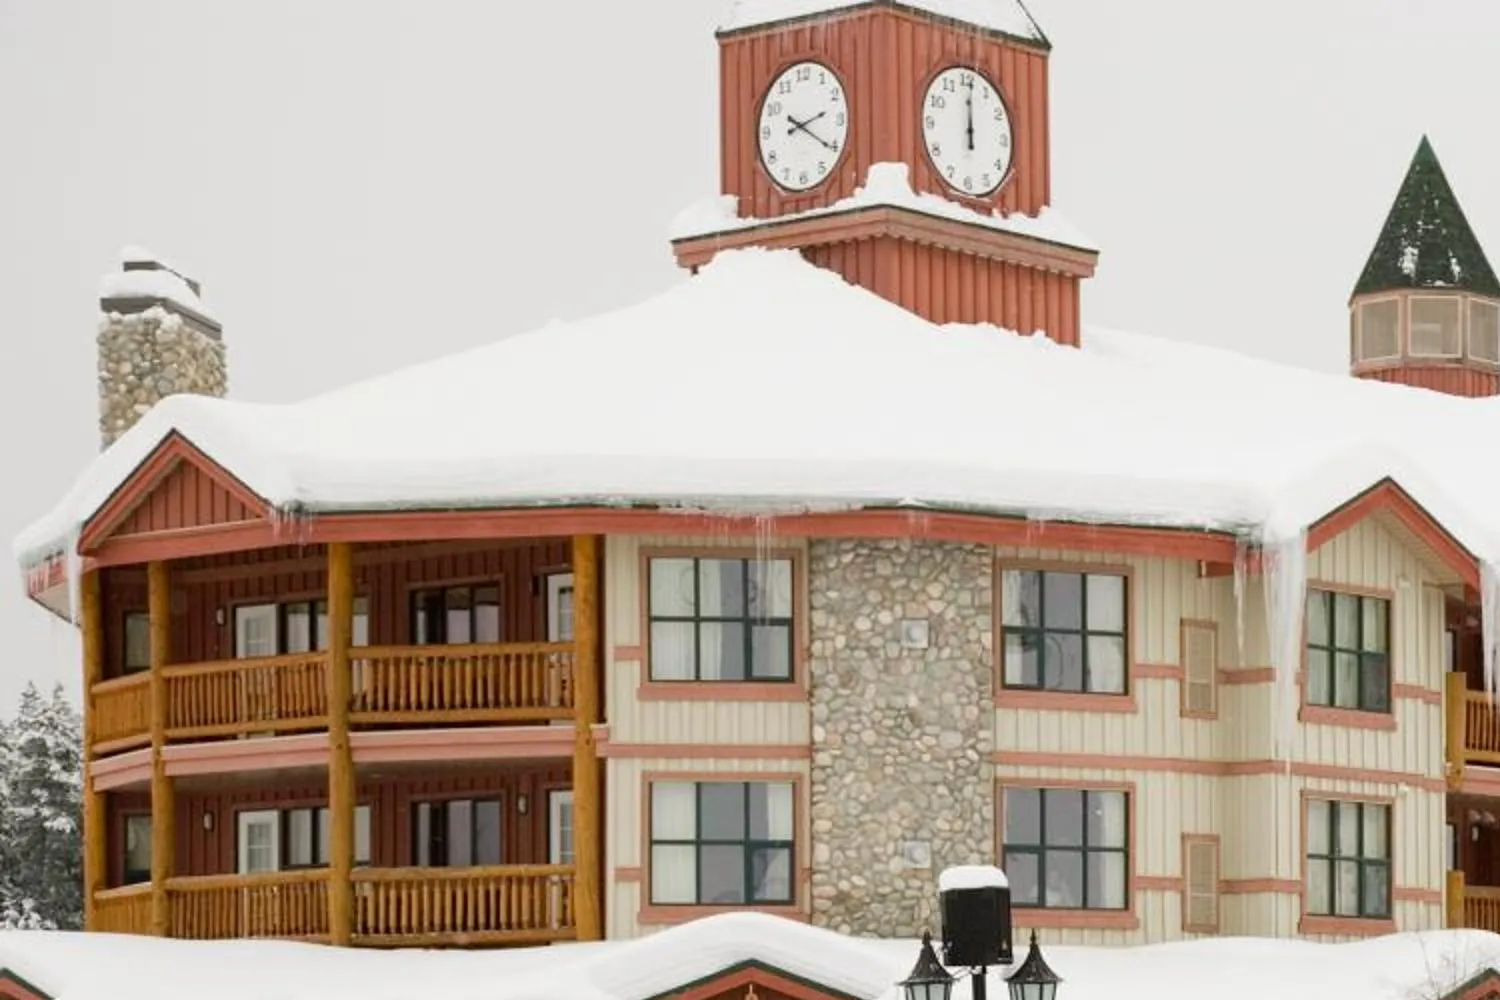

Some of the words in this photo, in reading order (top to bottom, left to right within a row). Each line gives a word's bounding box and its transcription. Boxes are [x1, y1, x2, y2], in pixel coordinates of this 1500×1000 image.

[797, 67, 810, 82] 12
[779, 80, 791, 94] 11
[943, 77, 955, 92] 11
[931, 95, 945, 108] 10
[767, 102, 781, 117] 10
